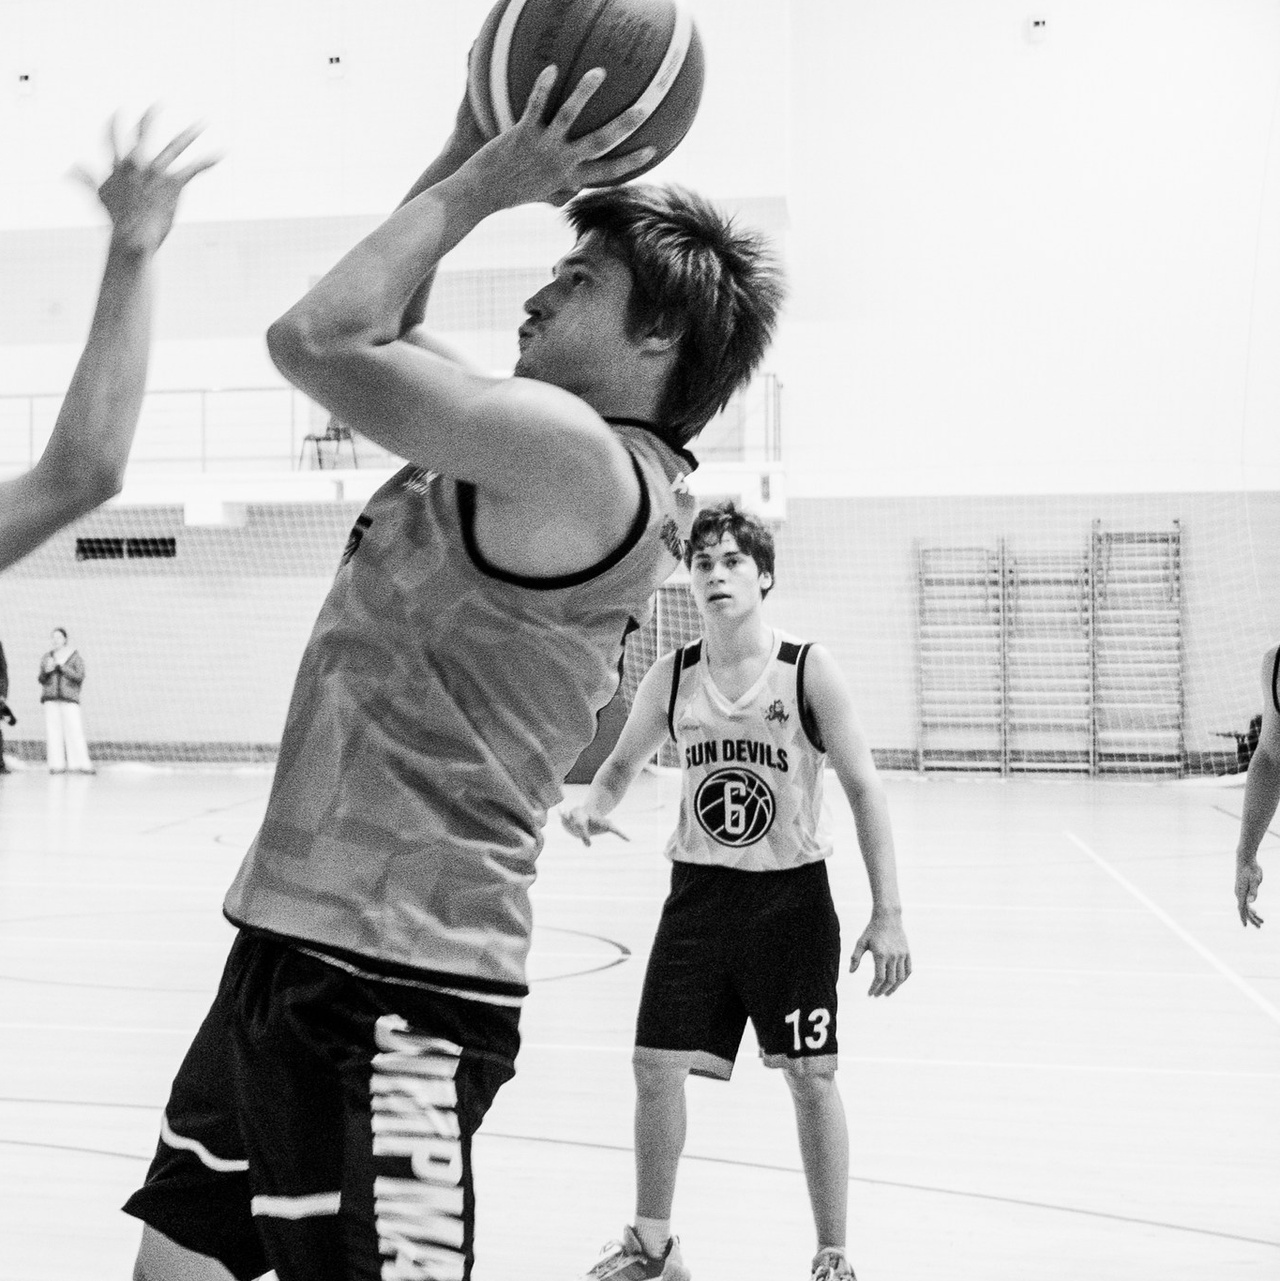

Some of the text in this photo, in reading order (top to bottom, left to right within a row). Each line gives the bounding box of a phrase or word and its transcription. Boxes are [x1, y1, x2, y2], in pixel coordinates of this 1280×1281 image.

[722, 739, 789, 773] DEVILS
[723, 780, 747, 835] 6
[784, 1007, 831, 1052] 13
